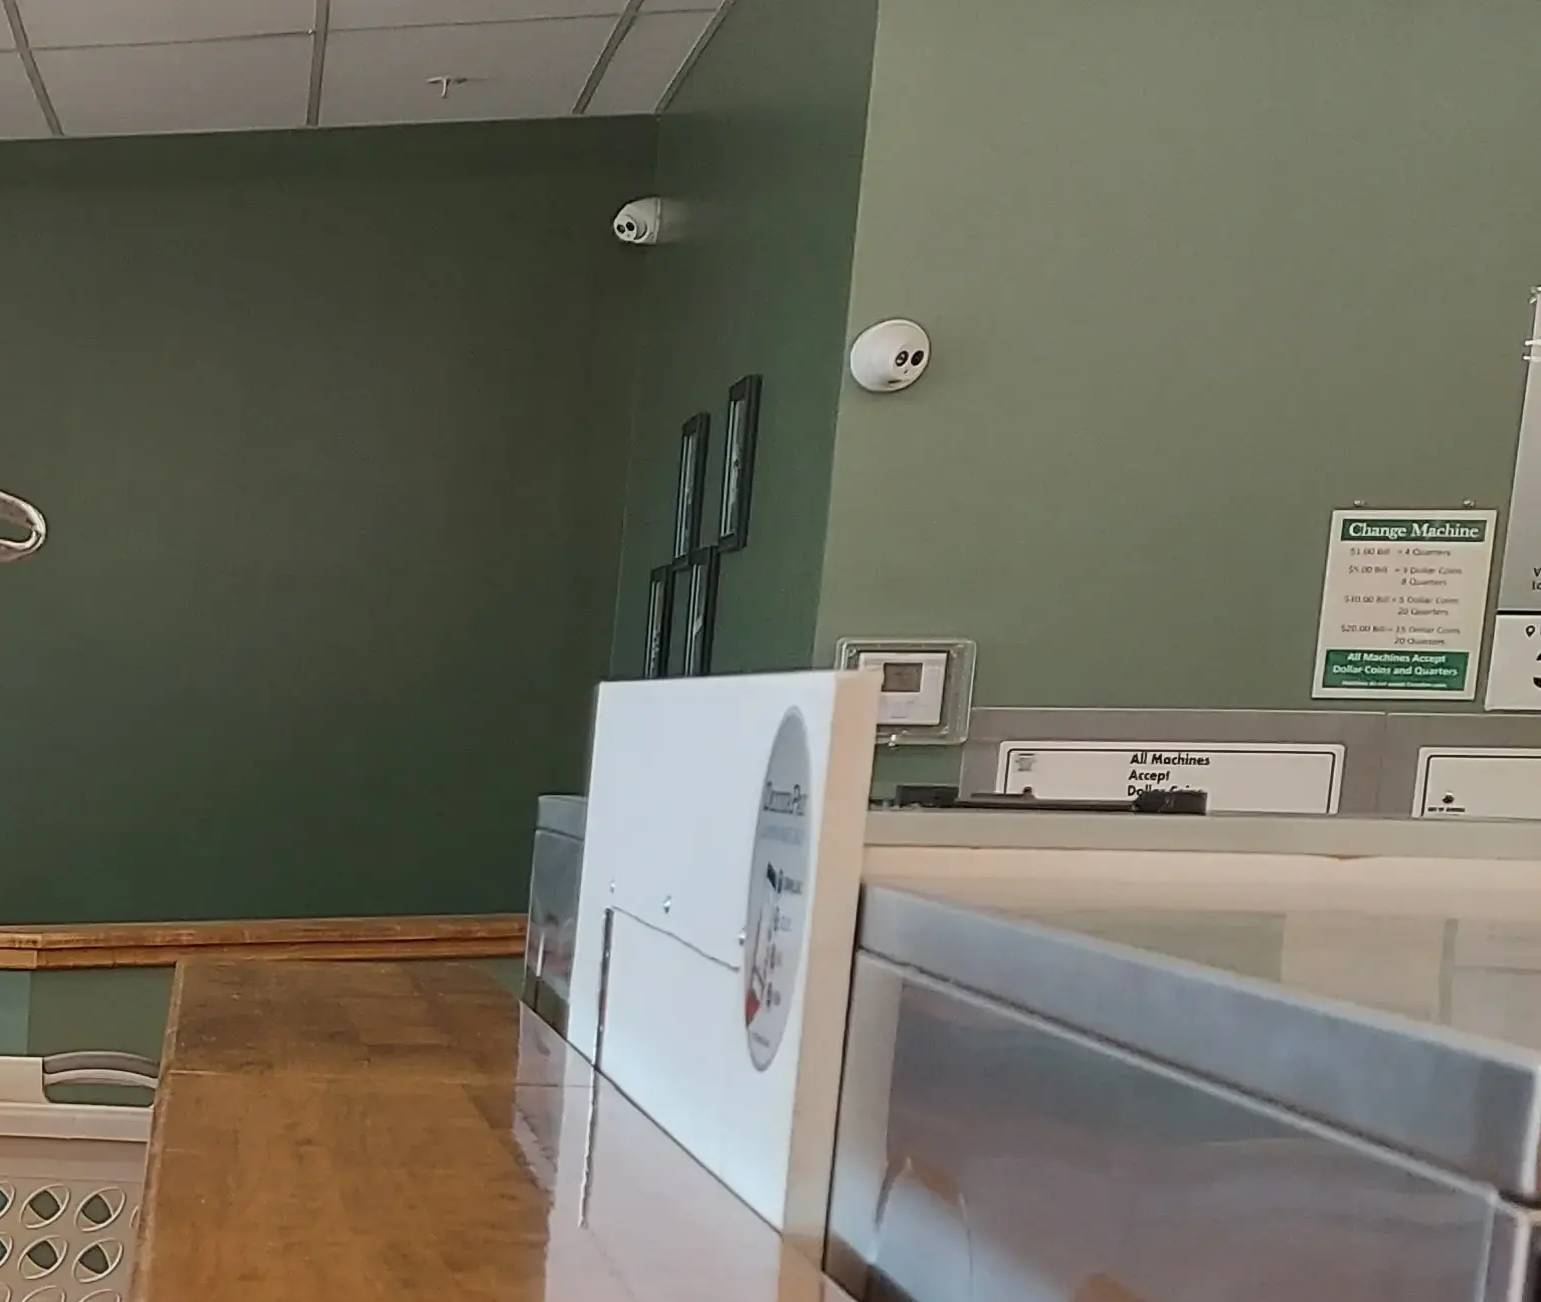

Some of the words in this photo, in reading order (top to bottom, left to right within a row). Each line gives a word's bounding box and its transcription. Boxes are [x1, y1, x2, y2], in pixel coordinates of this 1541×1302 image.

[1349, 522, 1407, 539] Change
[1411, 522, 1479, 538] Machine
[1347, 653, 1361, 661] All
[1363, 653, 1410, 663] Machines
[1412, 654, 1446, 664] Accept
[1333, 665, 1363, 673] Dollar
[1364, 665, 1390, 675] Coins
[1393, 666, 1412, 675] and
[1414, 666, 1457, 676] Quarters
[1130, 752, 1147, 764] All
[1152, 753, 1210, 765] Machines
[1128, 769, 1170, 784] Accept
[1127, 784, 1165, 796] Doll
